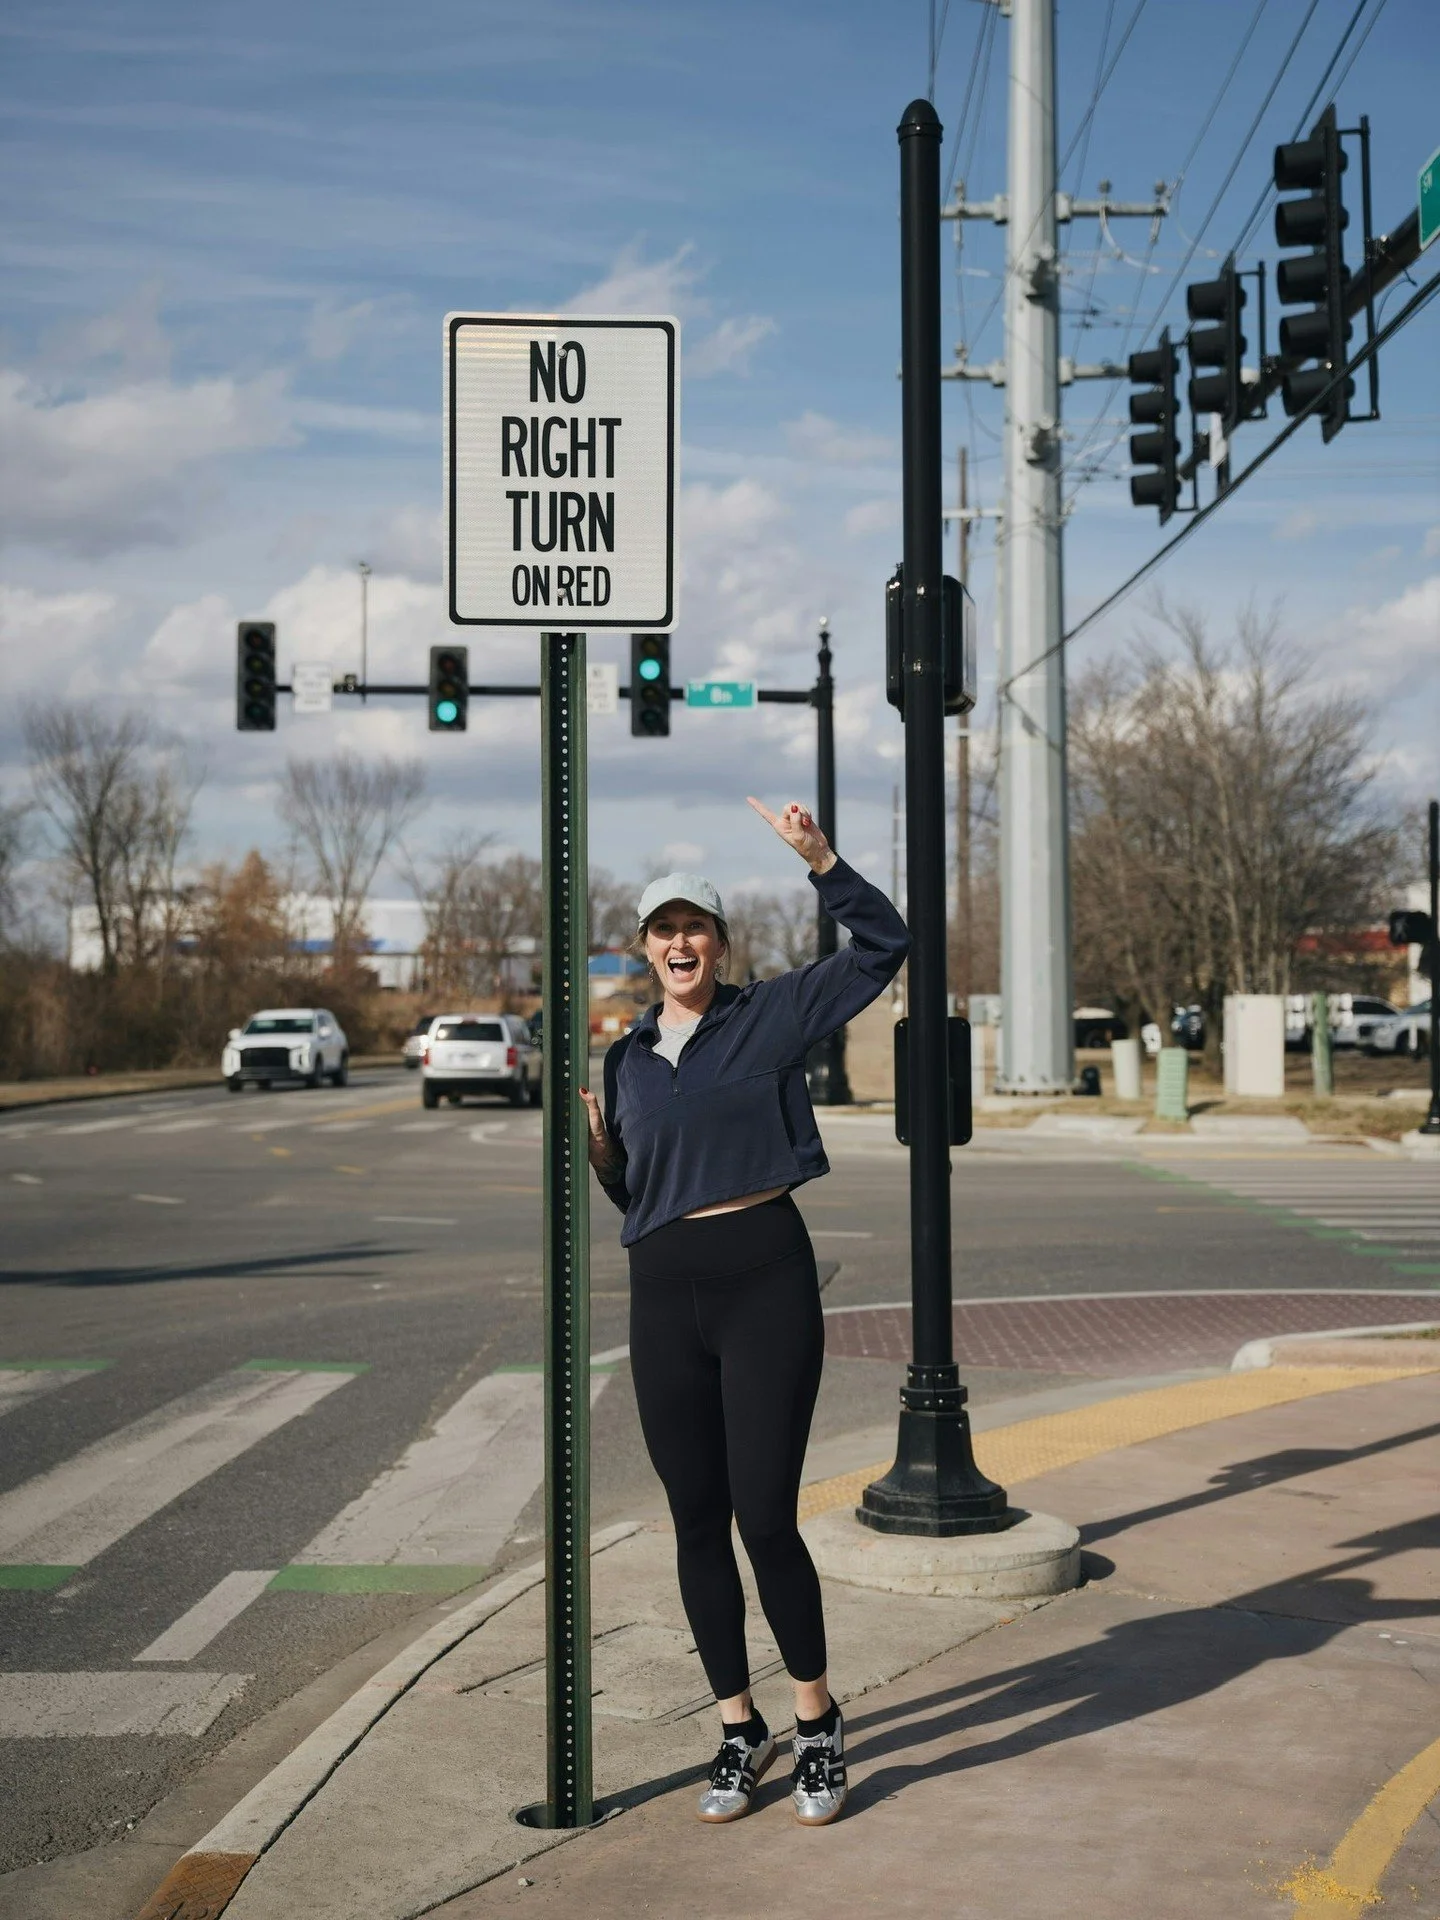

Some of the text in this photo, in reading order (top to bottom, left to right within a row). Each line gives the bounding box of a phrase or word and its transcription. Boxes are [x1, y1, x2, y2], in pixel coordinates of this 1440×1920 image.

[529, 340, 587, 404] NO
[501, 415, 622, 479] RIGHT
[505, 490, 615, 553] TURN
[511, 564, 611, 607] ON RED
